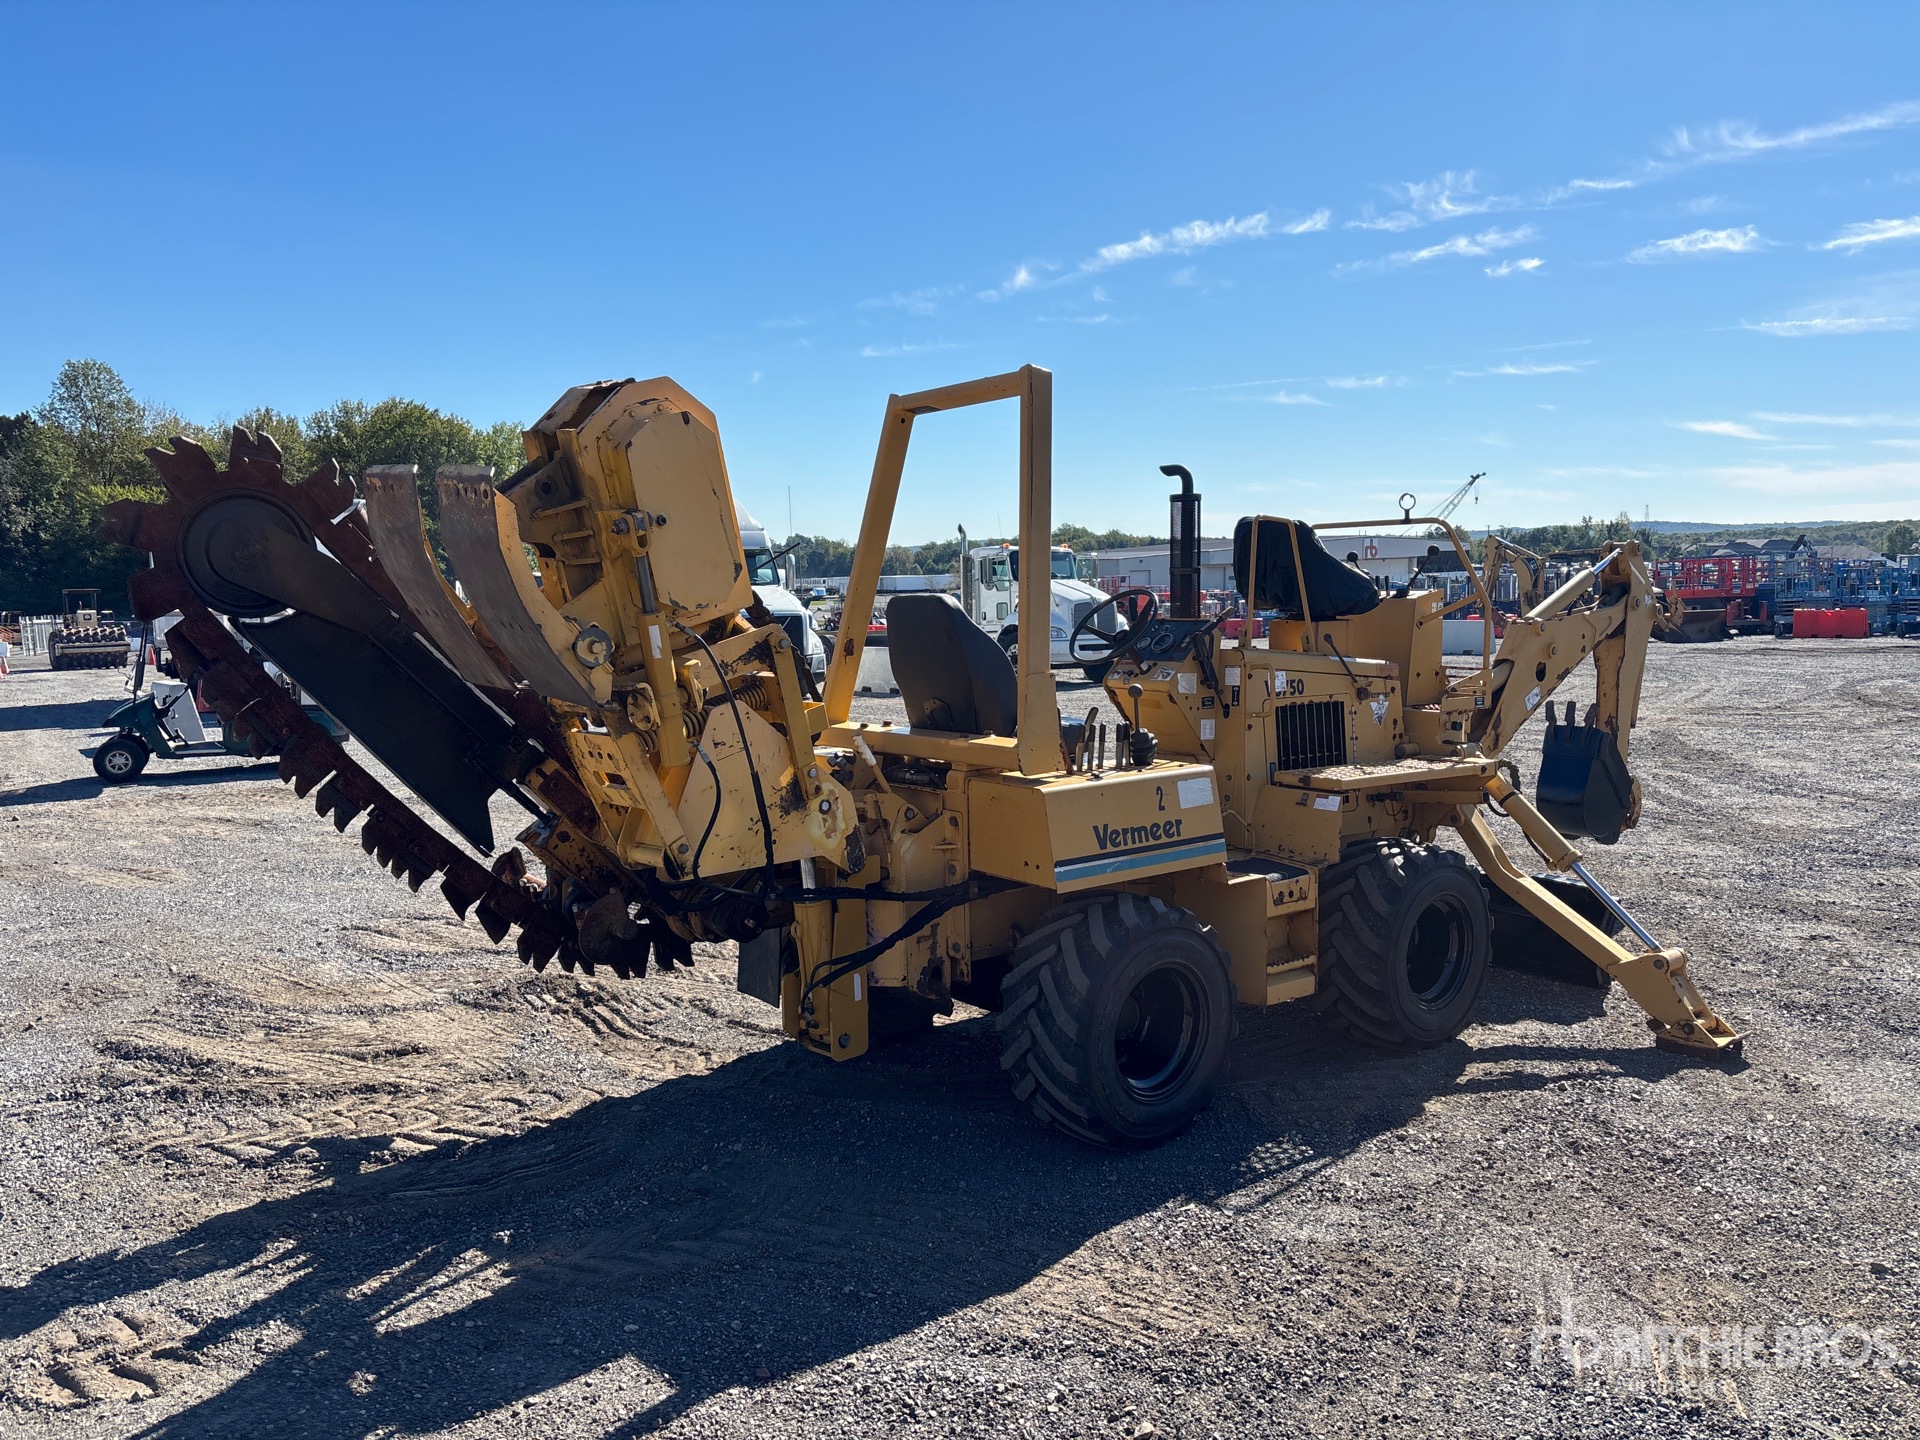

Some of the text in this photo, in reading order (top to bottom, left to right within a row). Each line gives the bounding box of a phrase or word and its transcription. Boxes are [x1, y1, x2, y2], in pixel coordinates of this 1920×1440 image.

[1365, 539, 1378, 558] rb
[1156, 785, 1165, 811] 2
[1092, 818, 1182, 851] Vermeer
